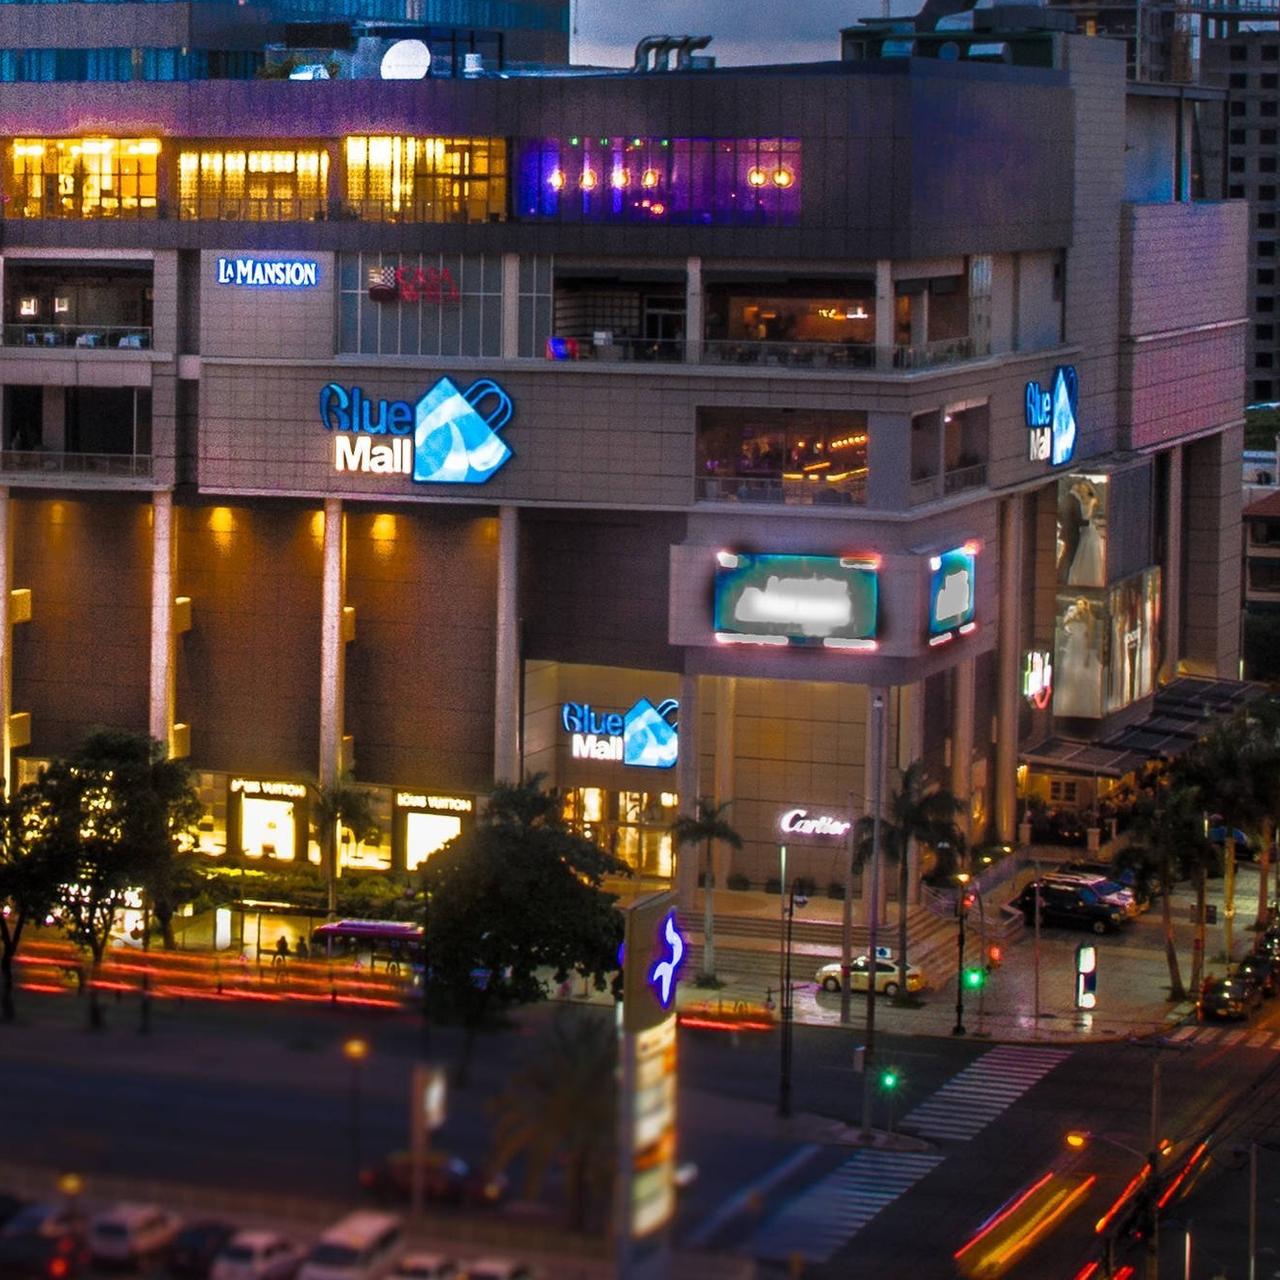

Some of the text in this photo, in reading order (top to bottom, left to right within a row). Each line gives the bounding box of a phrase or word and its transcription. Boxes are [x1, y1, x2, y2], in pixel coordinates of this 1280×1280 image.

[218, 258, 317, 286] LA MANSION
[319, 382, 413, 436] Blue
[1026, 382, 1051, 427] Blue
[335, 434, 412, 475] Mall
[1030, 427, 1051, 462] Mall
[562, 702, 624, 737] Blue
[572, 732, 624, 761] Mall
[780, 808, 852, 836] Cartier
